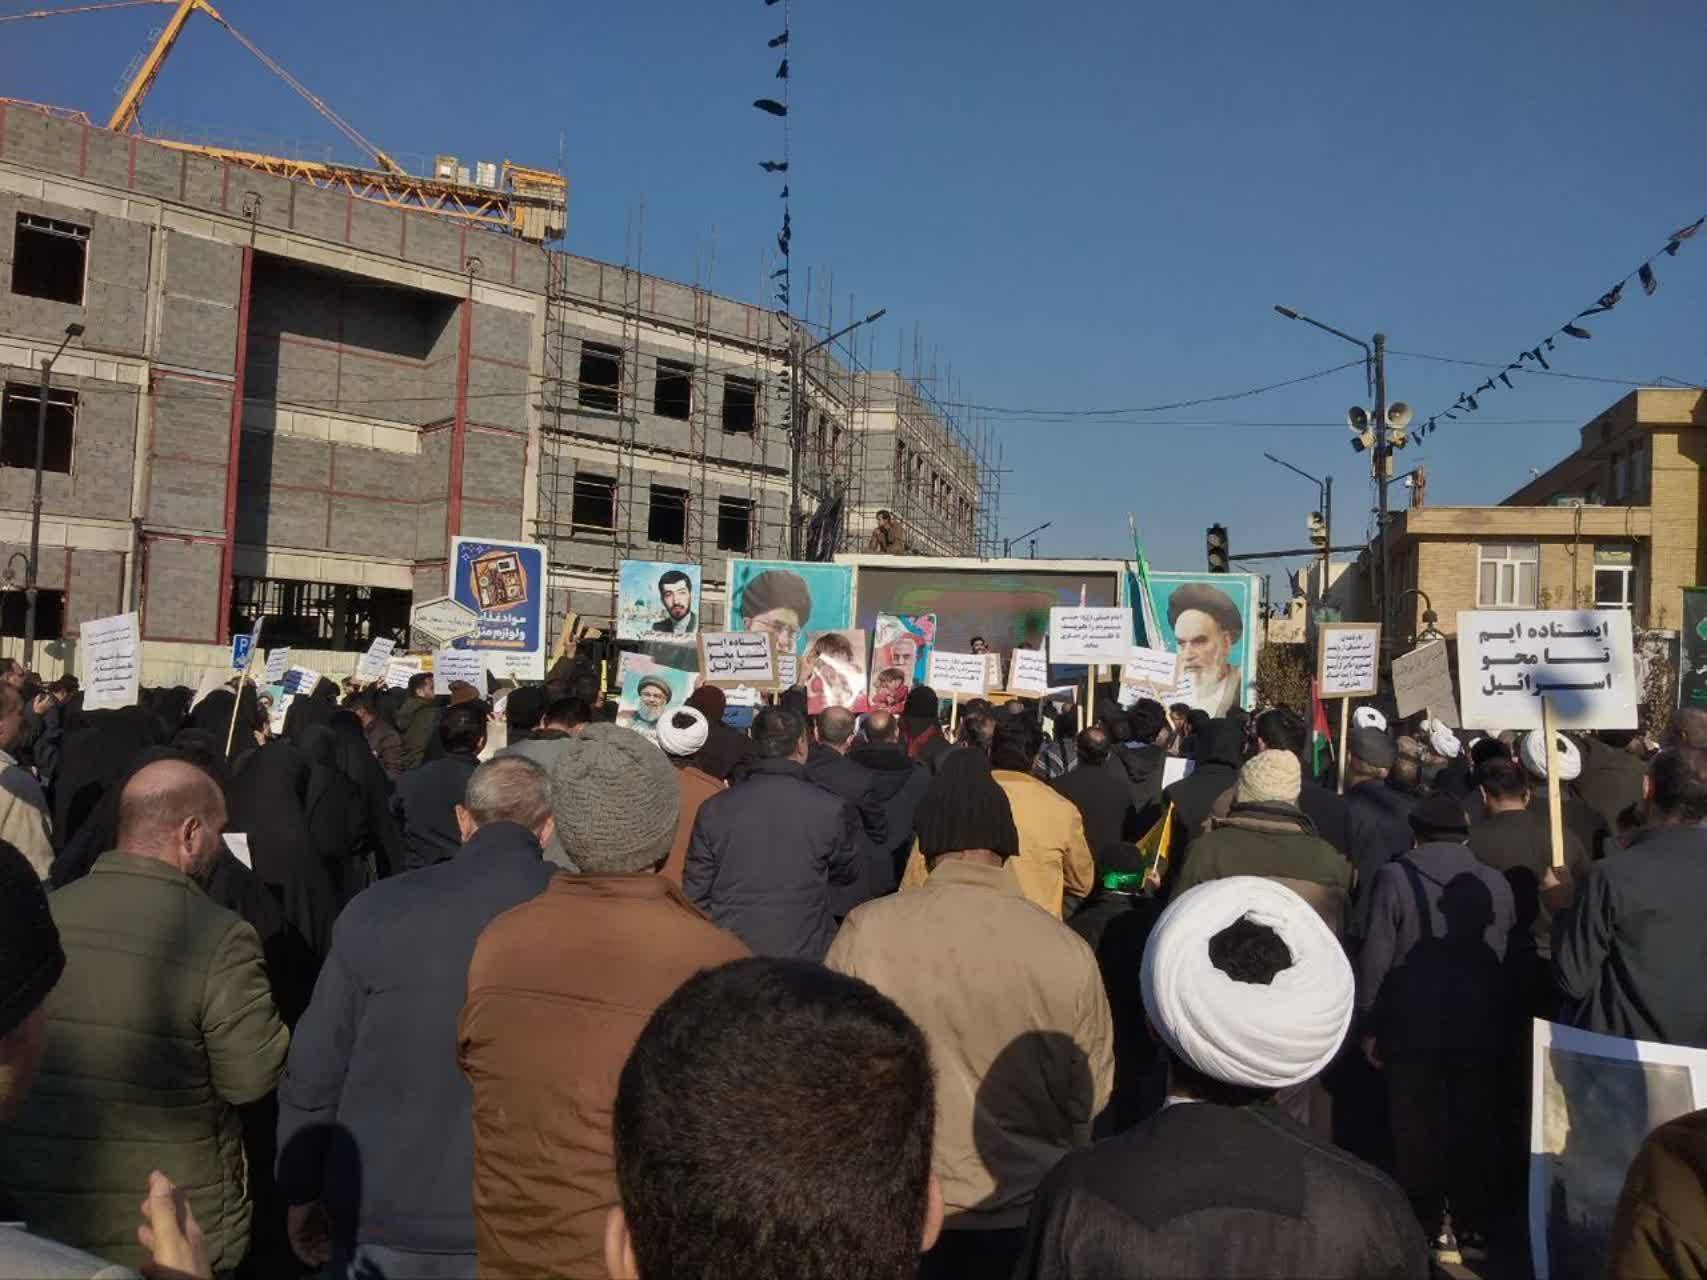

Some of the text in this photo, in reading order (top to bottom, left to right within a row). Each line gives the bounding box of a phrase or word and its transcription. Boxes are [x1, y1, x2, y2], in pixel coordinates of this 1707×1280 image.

[1479, 621, 1608, 644] ایستاده ایم
[239, 638, 249, 652] P
[707, 635, 766, 650] ایستاده ایم
[709, 650, 768, 662] تا محو
[1480, 647, 1611, 671] تا محو
[709, 660, 769, 673] اسرائیل
[1482, 672, 1612, 697] اسرائیل
